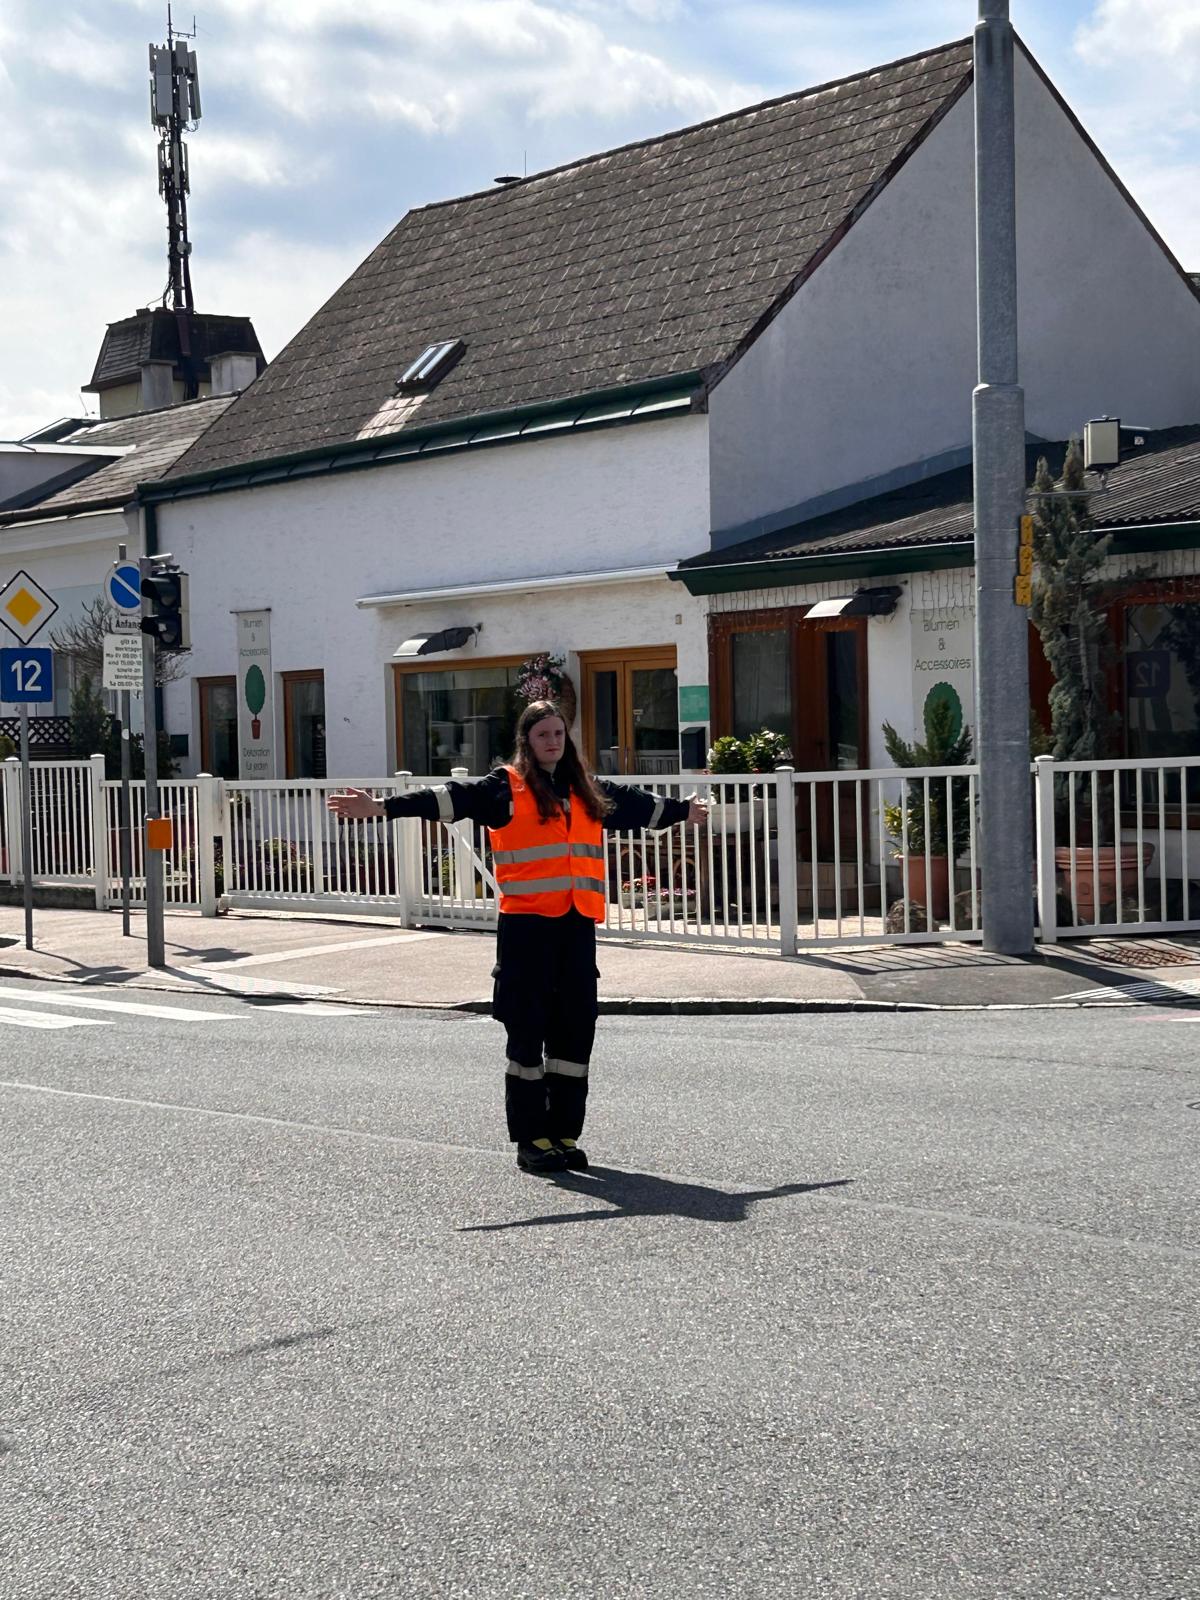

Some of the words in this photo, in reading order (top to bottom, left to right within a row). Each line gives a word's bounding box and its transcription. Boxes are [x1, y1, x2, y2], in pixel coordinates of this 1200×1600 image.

[115, 620, 141, 630] Anfang
[922, 619, 960, 632] Blumen
[938, 637, 946, 651] &
[914, 658, 972, 671] Accessoires
[11, 660, 42, 692] 12
